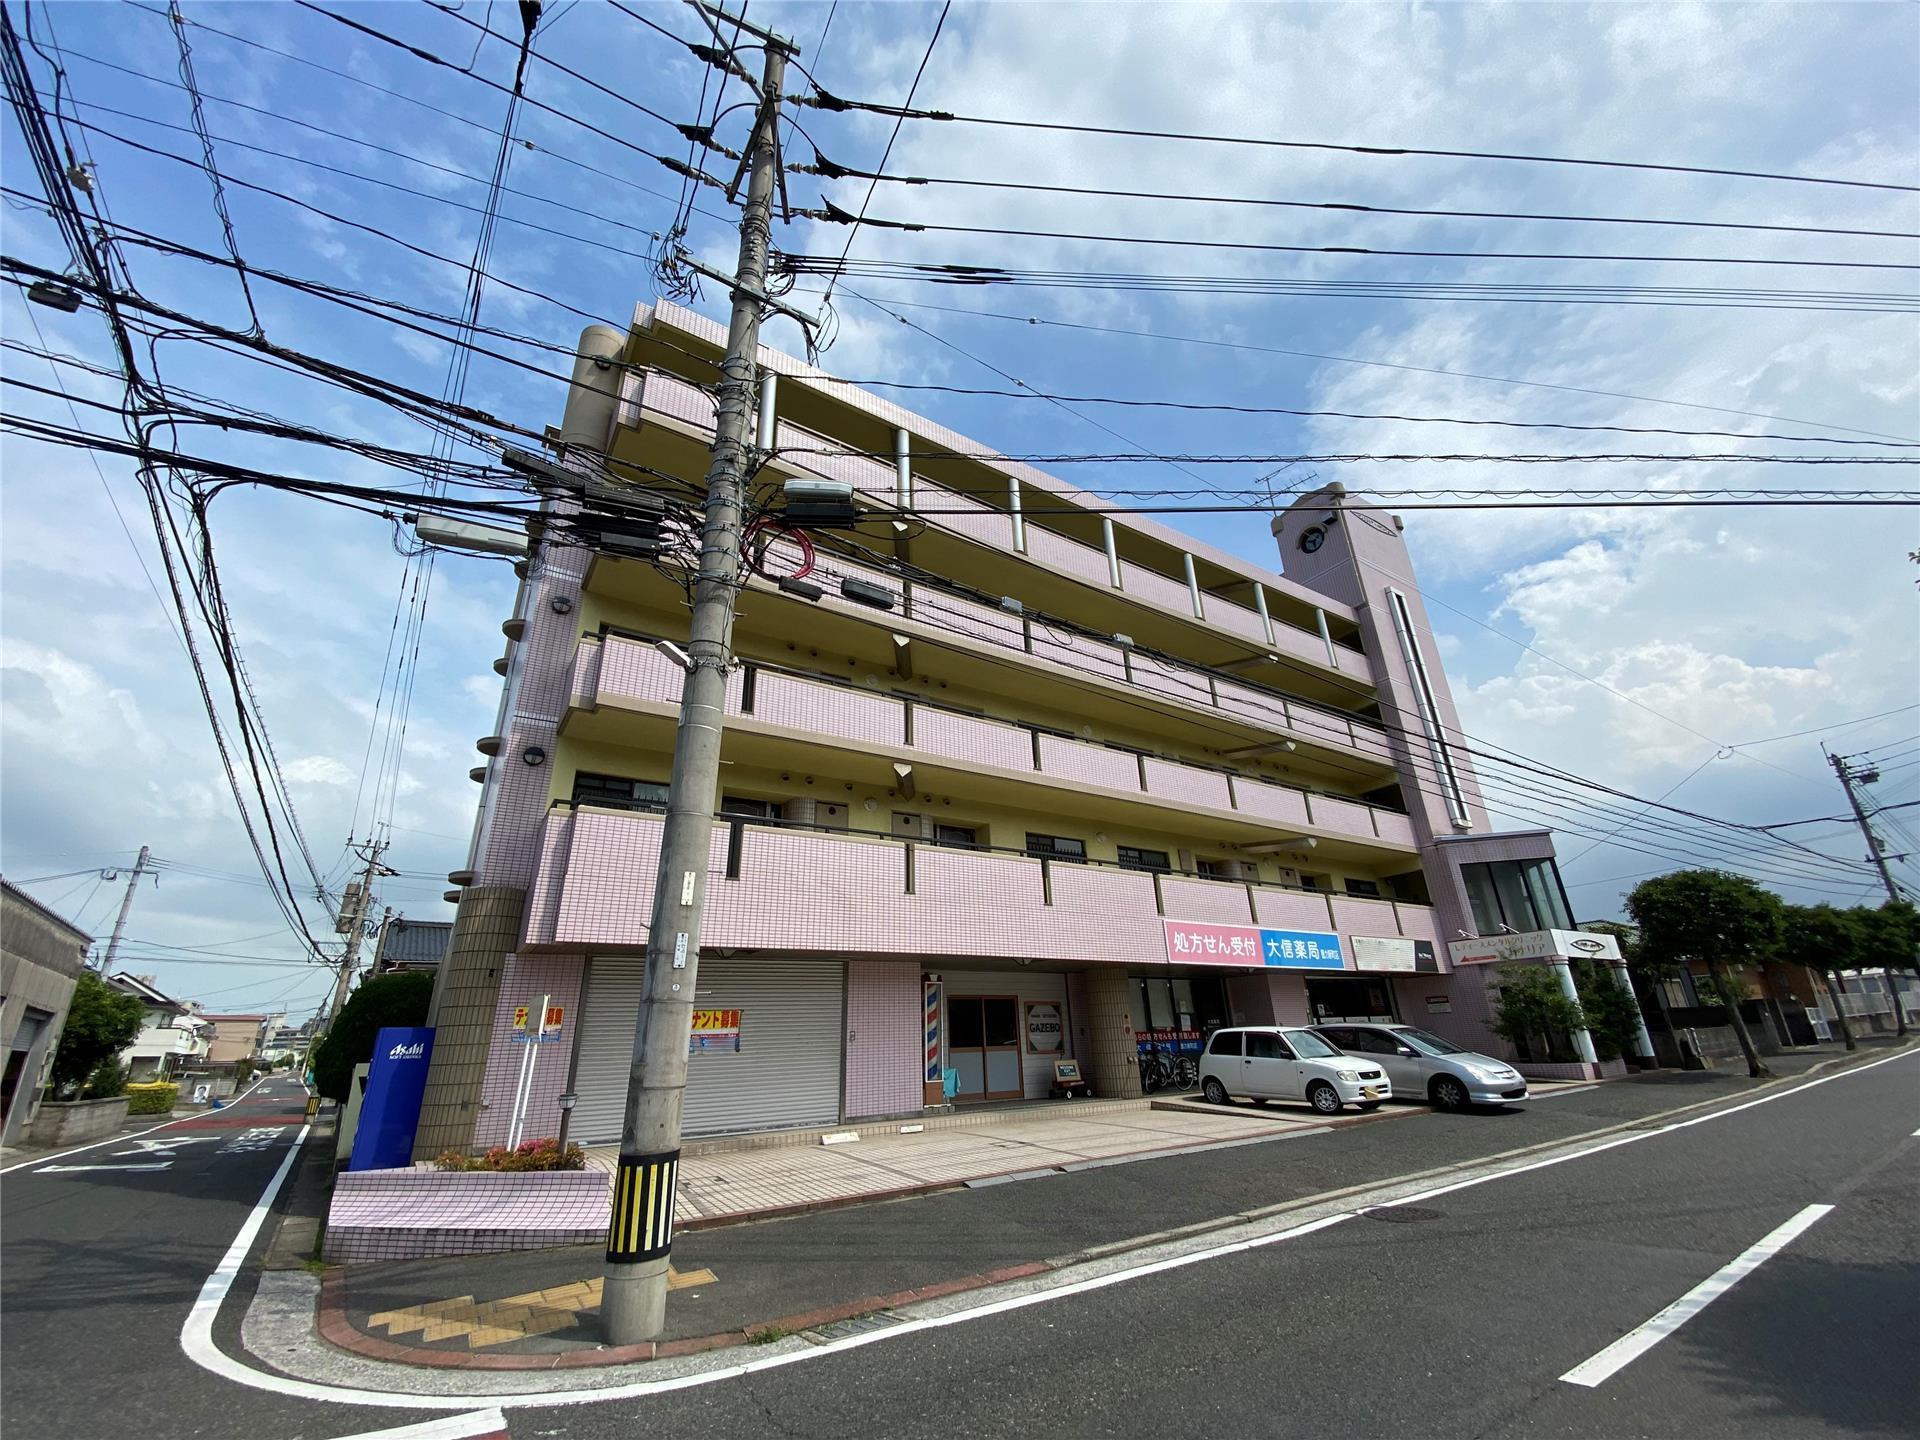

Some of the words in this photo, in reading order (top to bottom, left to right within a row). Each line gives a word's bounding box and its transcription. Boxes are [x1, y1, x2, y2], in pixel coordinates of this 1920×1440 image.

[1173, 931, 1257, 957] 処方せん受付
[1266, 938, 1321, 960] 大信薬局
[1030, 1023, 1060, 1033] GAZEBO
[390, 1042, 424, 1055] Asahi
